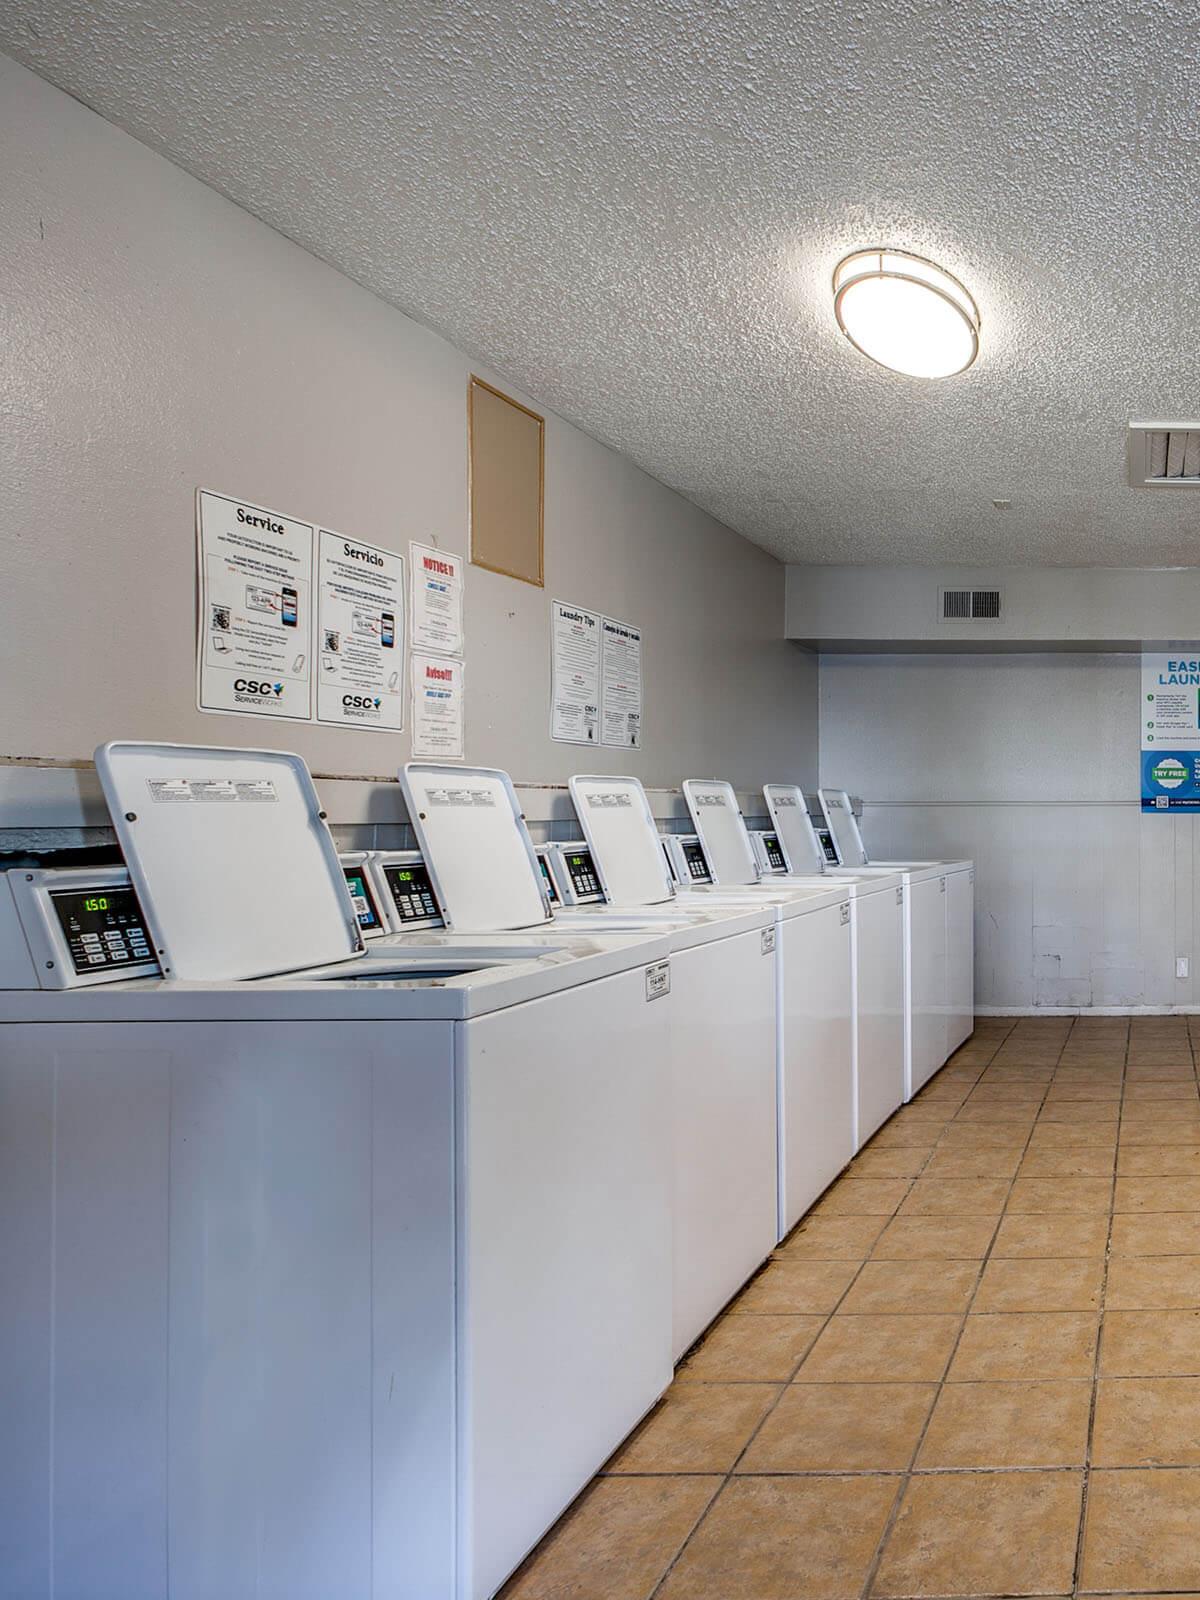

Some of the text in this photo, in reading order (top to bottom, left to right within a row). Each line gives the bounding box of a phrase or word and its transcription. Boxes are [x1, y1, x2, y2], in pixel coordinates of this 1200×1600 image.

[236, 508, 285, 535] Service
[344, 544, 384, 567] Servicio
[560, 608, 595, 627] Laundry Tips
[234, 678, 271, 695] CSC
[342, 694, 372, 708] CSC
